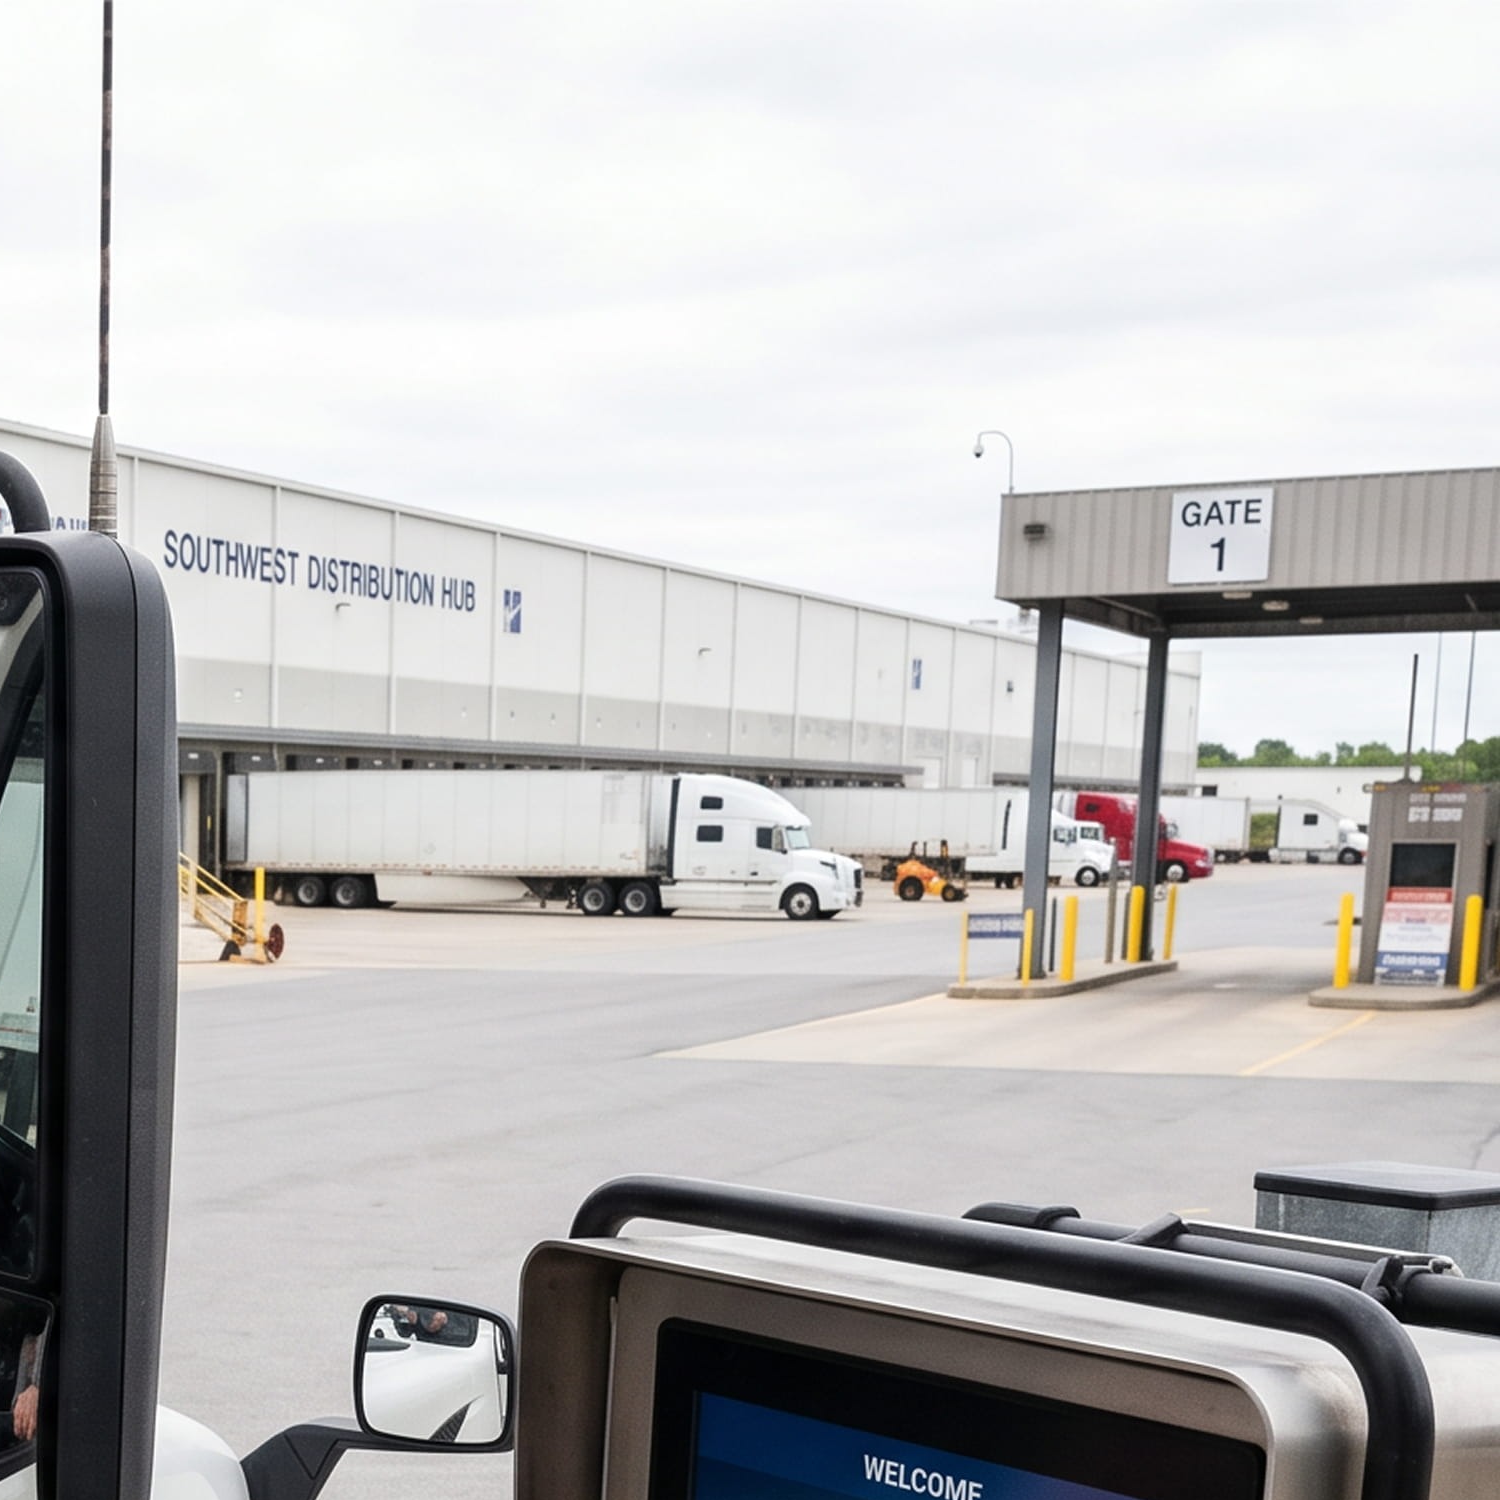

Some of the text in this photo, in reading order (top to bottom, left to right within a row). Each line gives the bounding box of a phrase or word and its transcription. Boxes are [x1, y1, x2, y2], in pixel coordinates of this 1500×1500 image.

[1181, 498, 1263, 528] GATE
[163, 529, 476, 613] SOUTHWEST DISTRIBUTION HUB
[1210, 536, 1226, 572] 1
